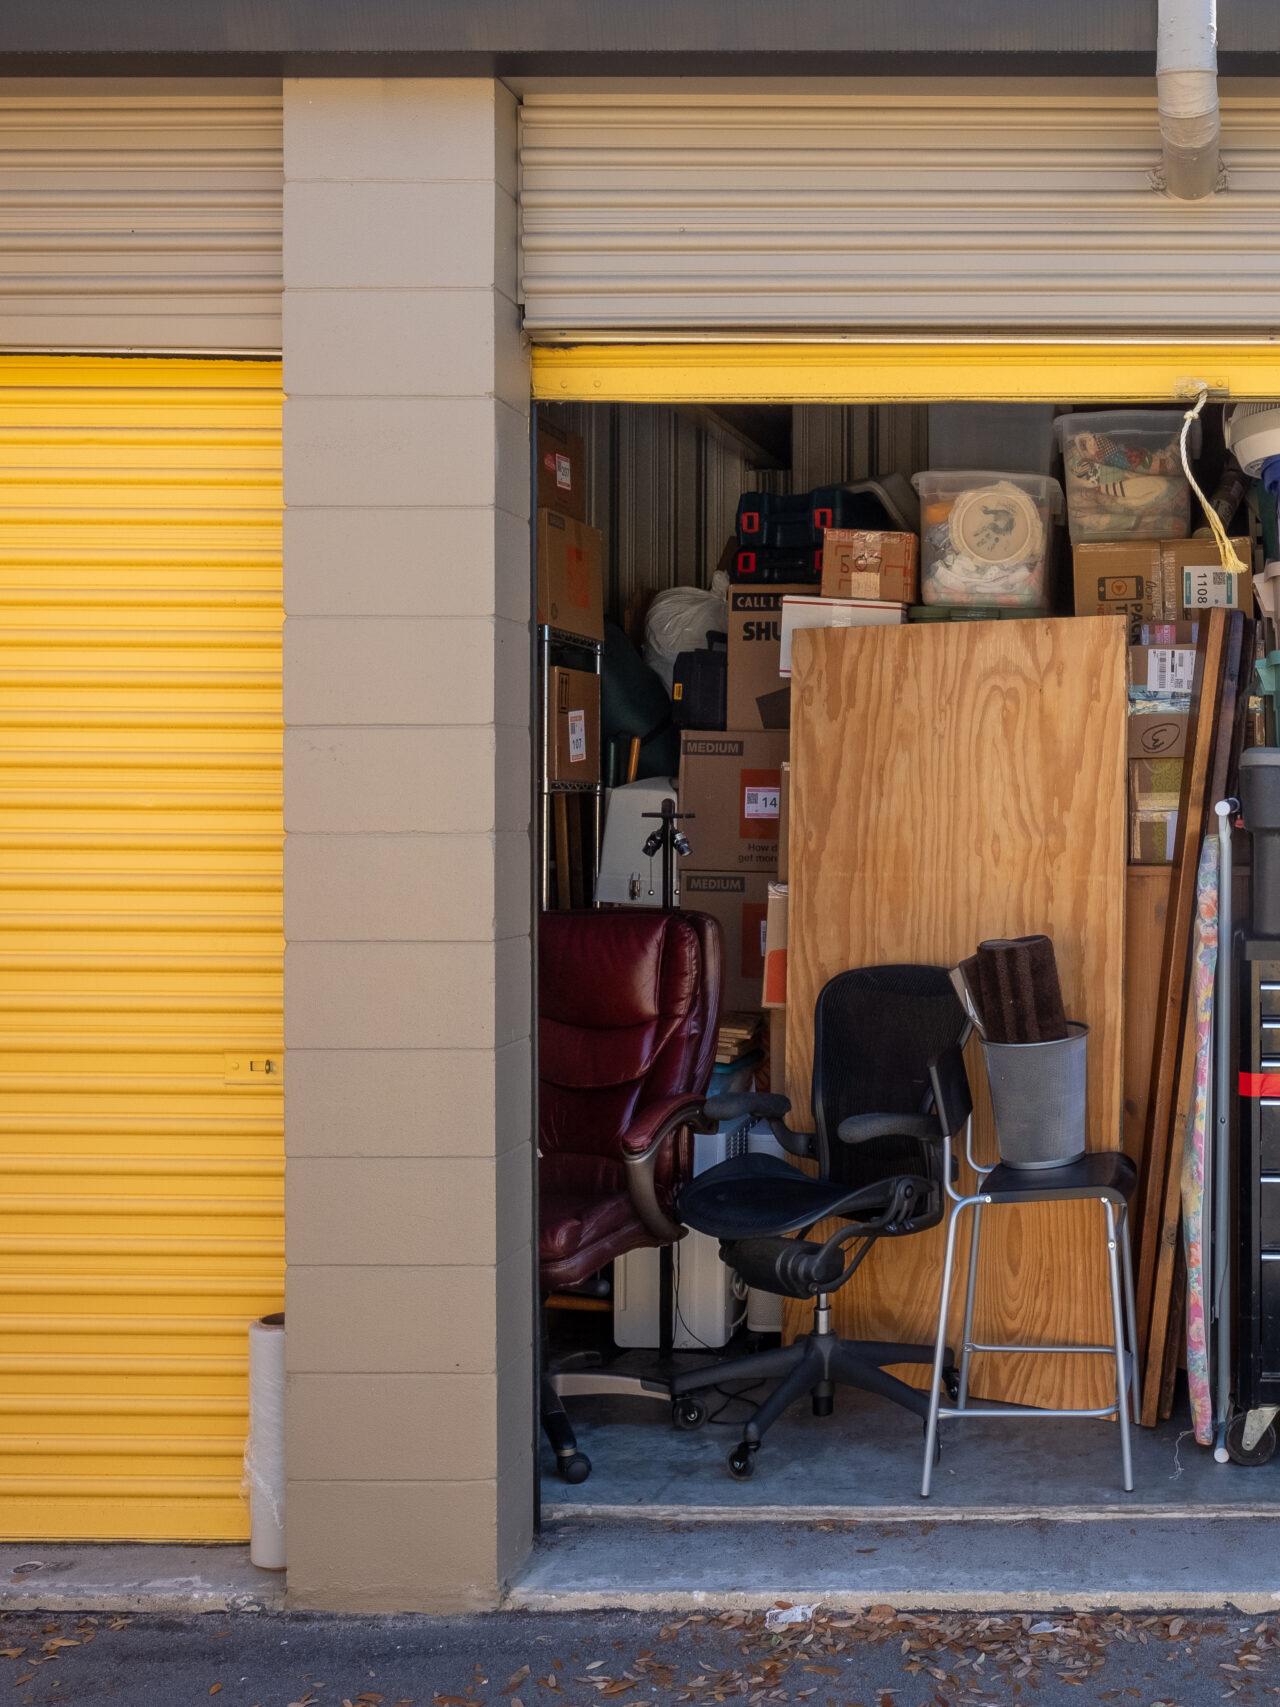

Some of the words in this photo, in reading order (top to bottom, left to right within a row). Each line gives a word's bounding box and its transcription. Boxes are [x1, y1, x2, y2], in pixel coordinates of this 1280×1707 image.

[1197, 573, 1208, 604] 1108
[737, 596, 765, 608] CALL
[686, 742, 738, 753] MEDIUM
[761, 797, 778, 808] 14
[748, 843, 769, 852] How
[738, 854, 753, 863] get
[690, 878, 741, 889] MEDIUM
